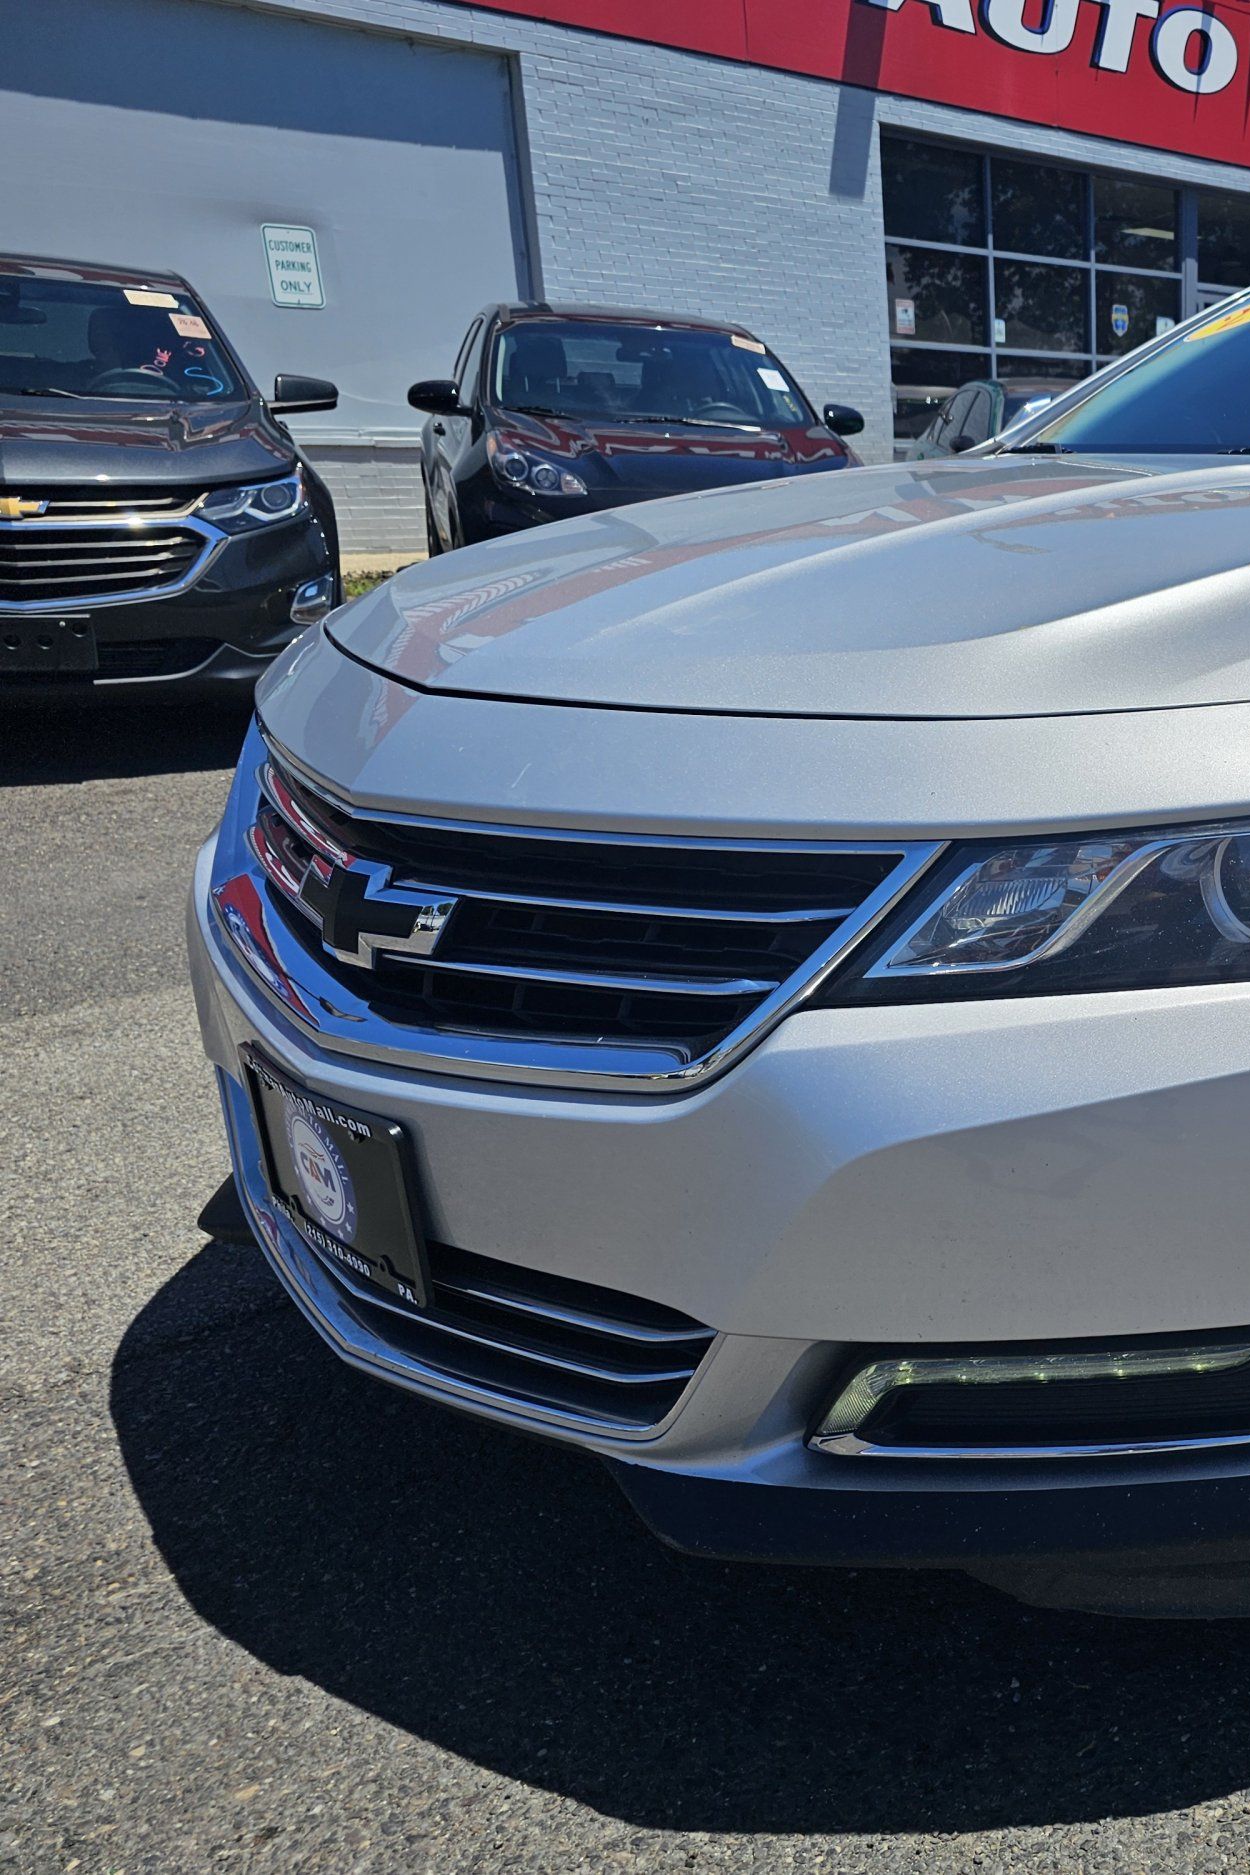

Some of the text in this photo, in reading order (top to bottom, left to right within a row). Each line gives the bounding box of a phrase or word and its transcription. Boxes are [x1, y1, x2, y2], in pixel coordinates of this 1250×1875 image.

[268, 239, 313, 254] CUSTOMER
[275, 259, 312, 273] PARKING
[280, 279, 312, 293] ONLY
[304, 1221, 327, 1248] (215)
[397, 1282, 419, 1305] PA.
